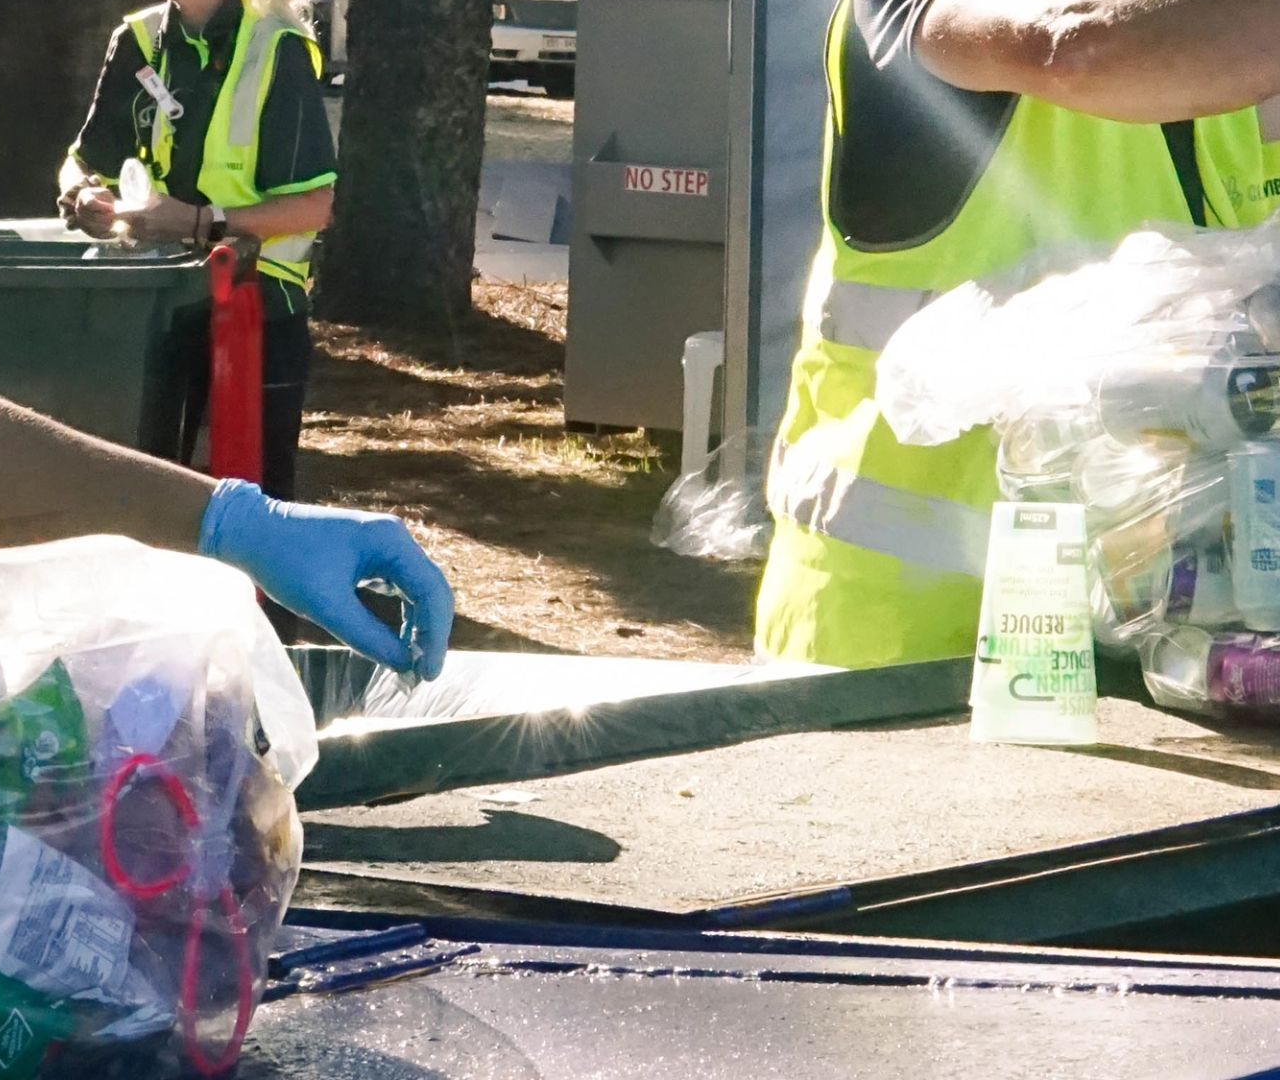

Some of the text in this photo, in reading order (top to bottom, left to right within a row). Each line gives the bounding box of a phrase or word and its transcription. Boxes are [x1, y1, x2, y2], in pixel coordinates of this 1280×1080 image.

[626, 167, 707, 194] NO STEP
[1000, 614, 1064, 635] REDUCE
[987, 635, 1054, 658] RETUR
[1051, 649, 1092, 672] EDUCE
